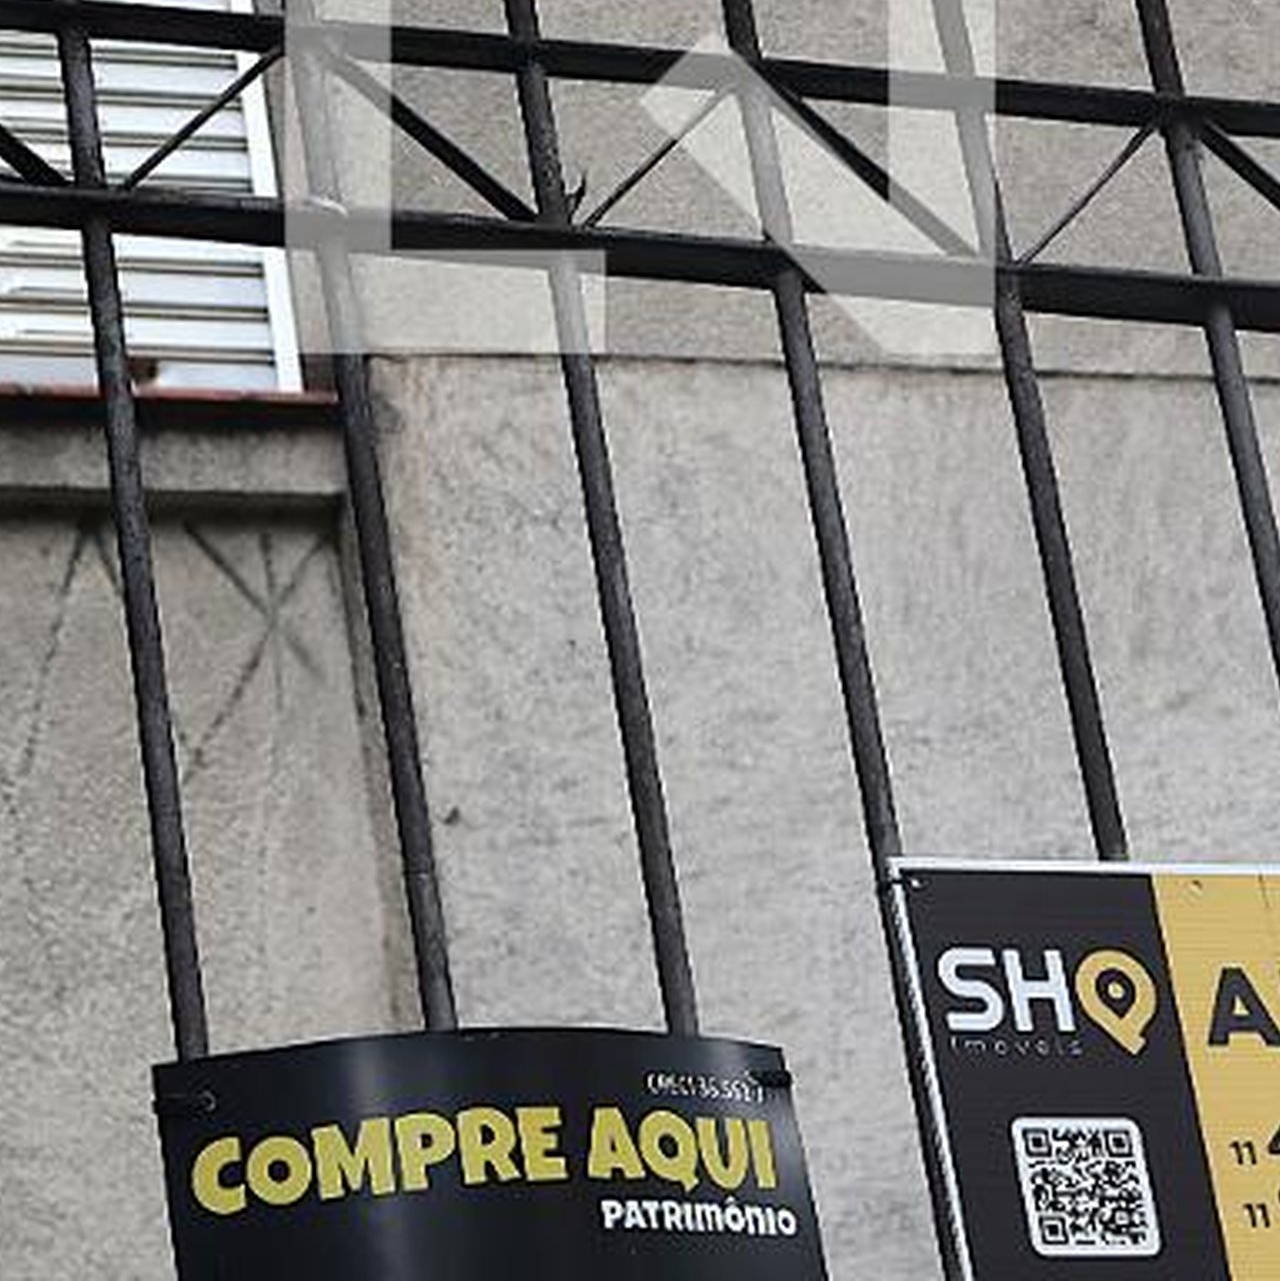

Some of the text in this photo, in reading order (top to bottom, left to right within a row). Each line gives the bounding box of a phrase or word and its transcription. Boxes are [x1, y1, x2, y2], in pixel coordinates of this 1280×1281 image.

[190, 1105, 776, 1216] COMPRE AQUI
[1231, 1139, 1259, 1165] 11
[1244, 1203, 1270, 1229] 11
